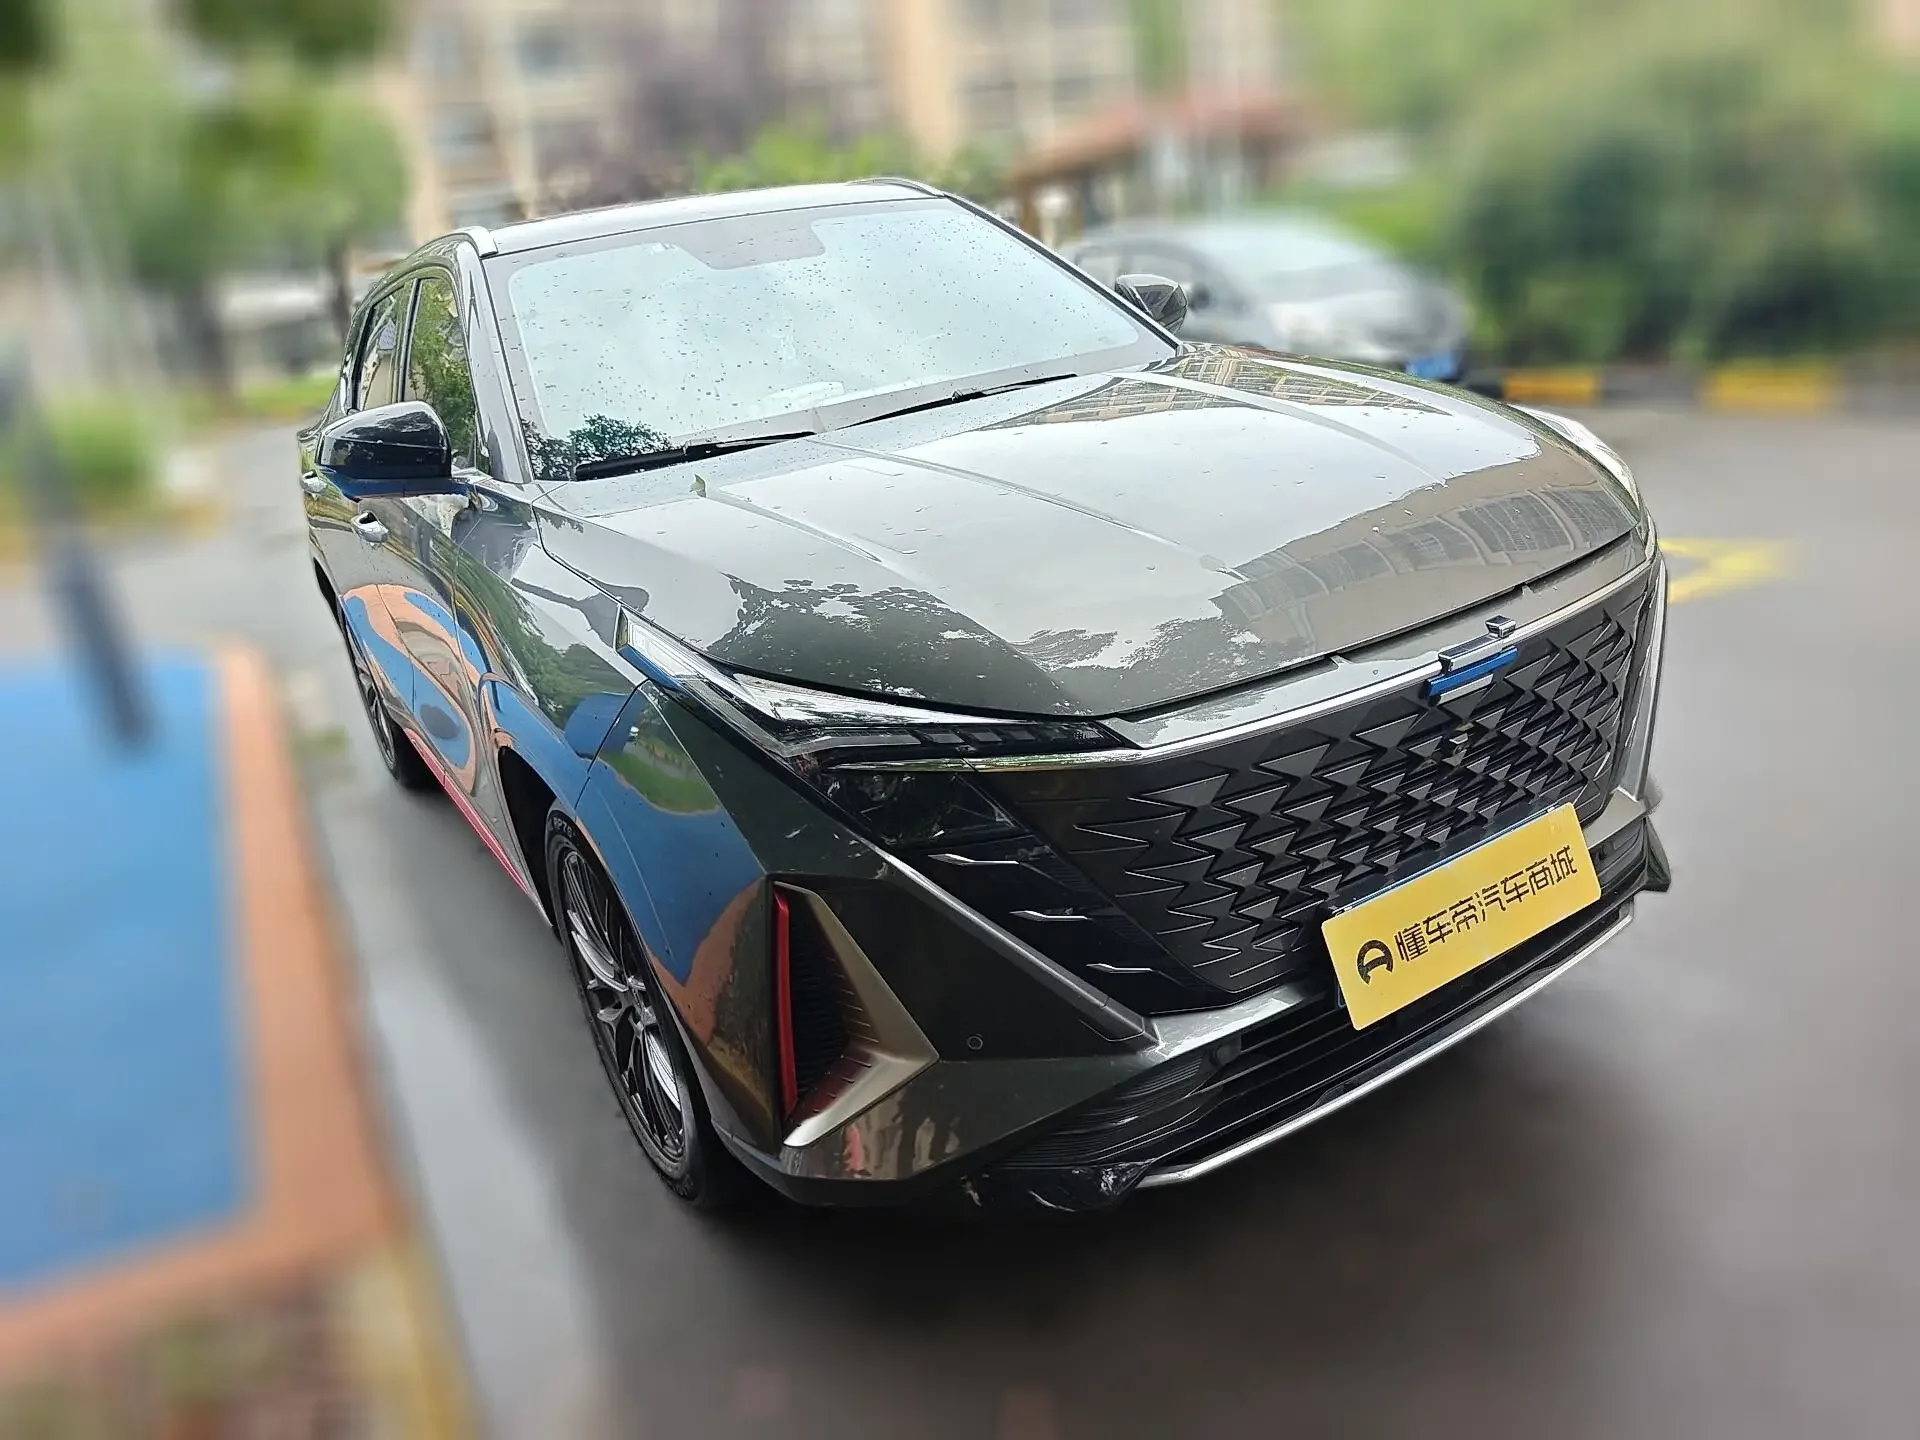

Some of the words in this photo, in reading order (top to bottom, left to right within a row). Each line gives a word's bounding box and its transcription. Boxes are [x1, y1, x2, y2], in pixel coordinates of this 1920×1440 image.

[1395, 845, 1578, 962] 懂车帝汽车商城
